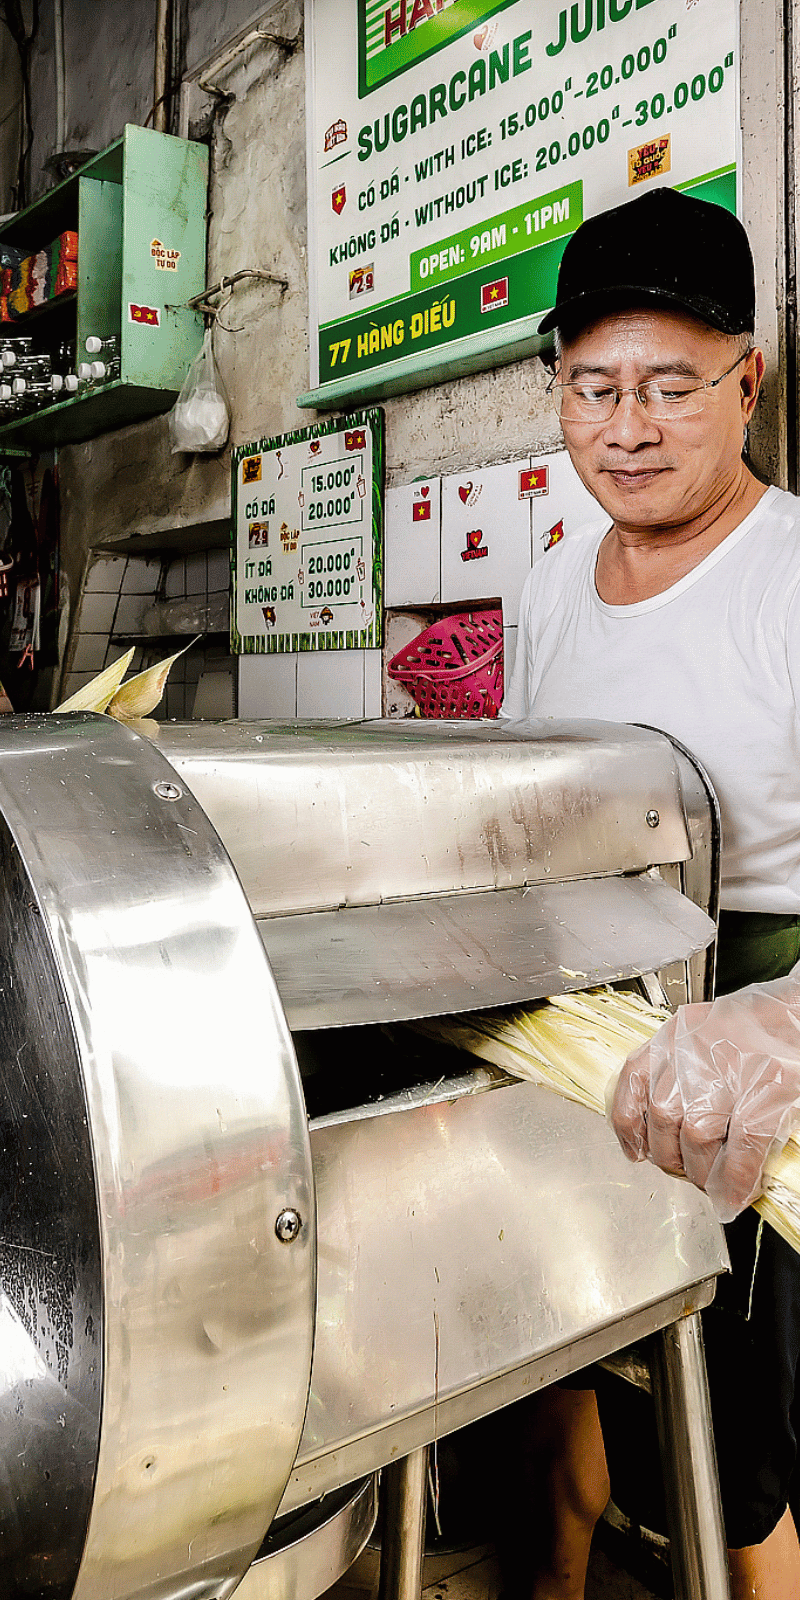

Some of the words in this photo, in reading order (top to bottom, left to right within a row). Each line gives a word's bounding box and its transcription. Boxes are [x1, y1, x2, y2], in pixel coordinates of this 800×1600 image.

[358, 31, 533, 162] SUGARCANE
[545, 0, 657, 57] JUIC
[358, 179, 375, 211] CÓ
[380, 166, 399, 200] ĐÁ
[414, 144, 455, 182] WITH
[461, 127, 492, 160] ICE:
[330, 229, 376, 266] KHÔNG
[380, 210, 399, 243] ĐÁ
[414, 173, 489, 227] WITHOUT
[495, 157, 528, 191] ICE:
[419, 244, 465, 278] OPEN:
[470, 223, 507, 257] 9AM
[524, 197, 570, 235] 11PM
[329, 338, 352, 367] 77
[357, 321, 405, 358] HÀNG
[409, 294, 456, 339] ĐIẾU
[245, 496, 259, 519] CÓ
[261, 493, 275, 516] ĐÁ
[244, 557, 255, 579] ÍT
[258, 554, 272, 577] ĐÁ
[245, 584, 278, 604] KHÔNG
[280, 579, 294, 600] ĐÁ
